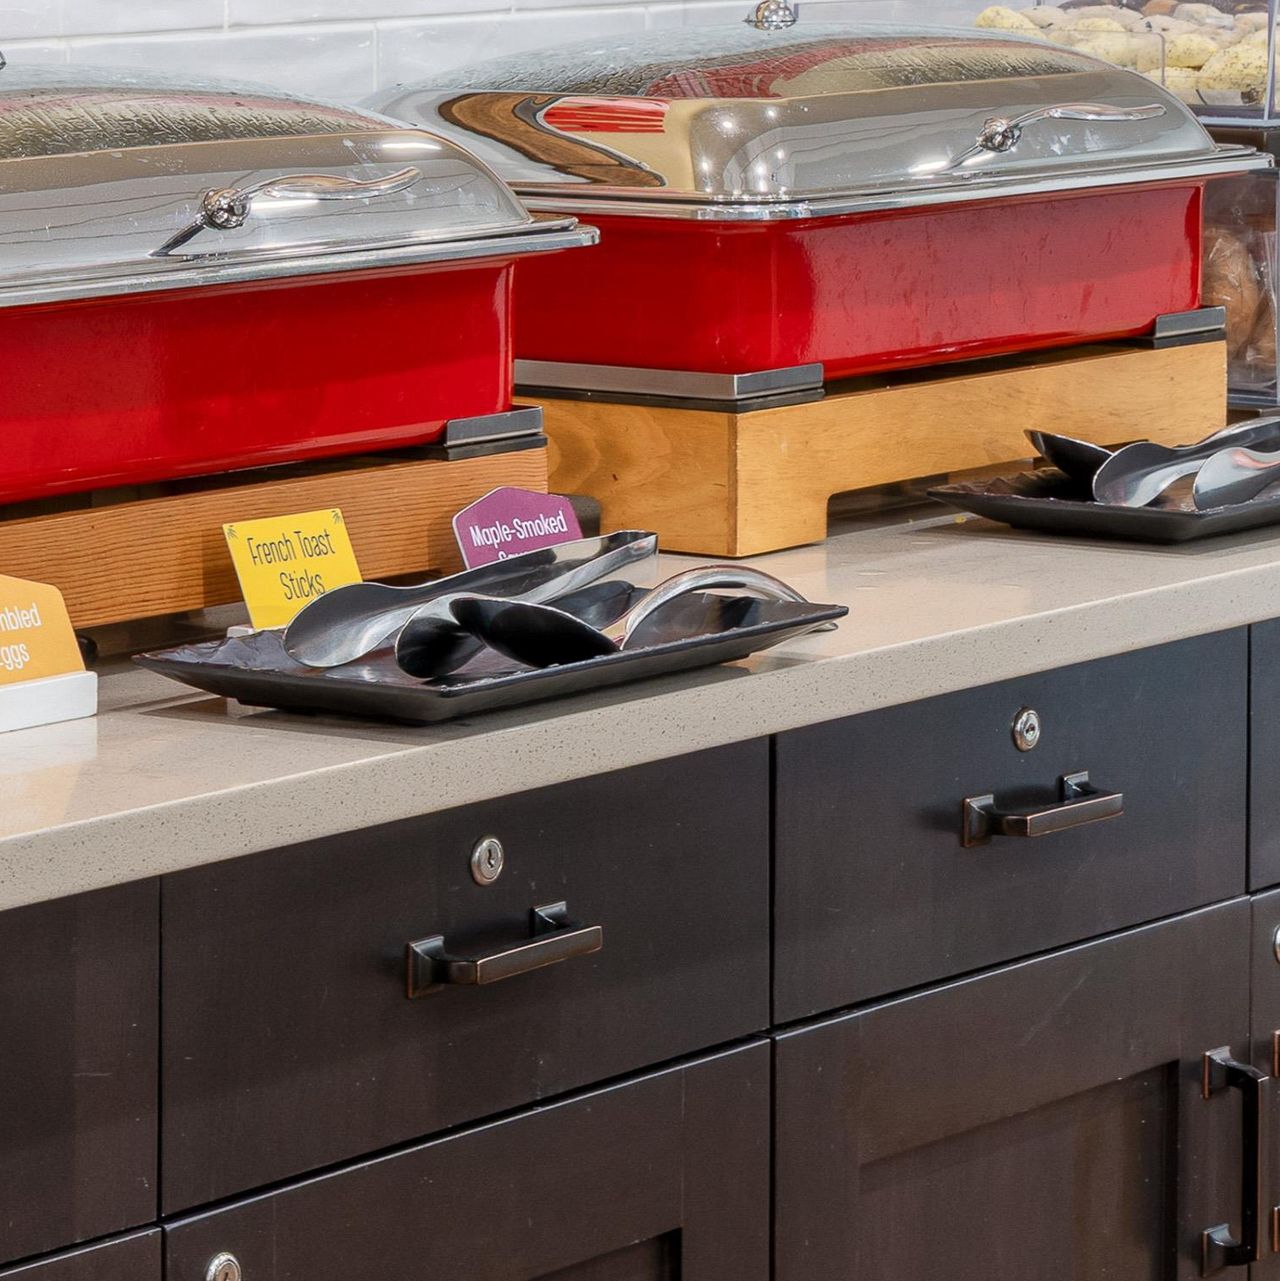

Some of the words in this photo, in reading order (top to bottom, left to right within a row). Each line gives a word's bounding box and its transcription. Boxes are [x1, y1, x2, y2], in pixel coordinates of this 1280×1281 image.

[247, 532, 297, 566] French
[294, 528, 336, 558] Toast
[469, 510, 569, 549] Maple-Smoked
[280, 568, 326, 600] Sticks
